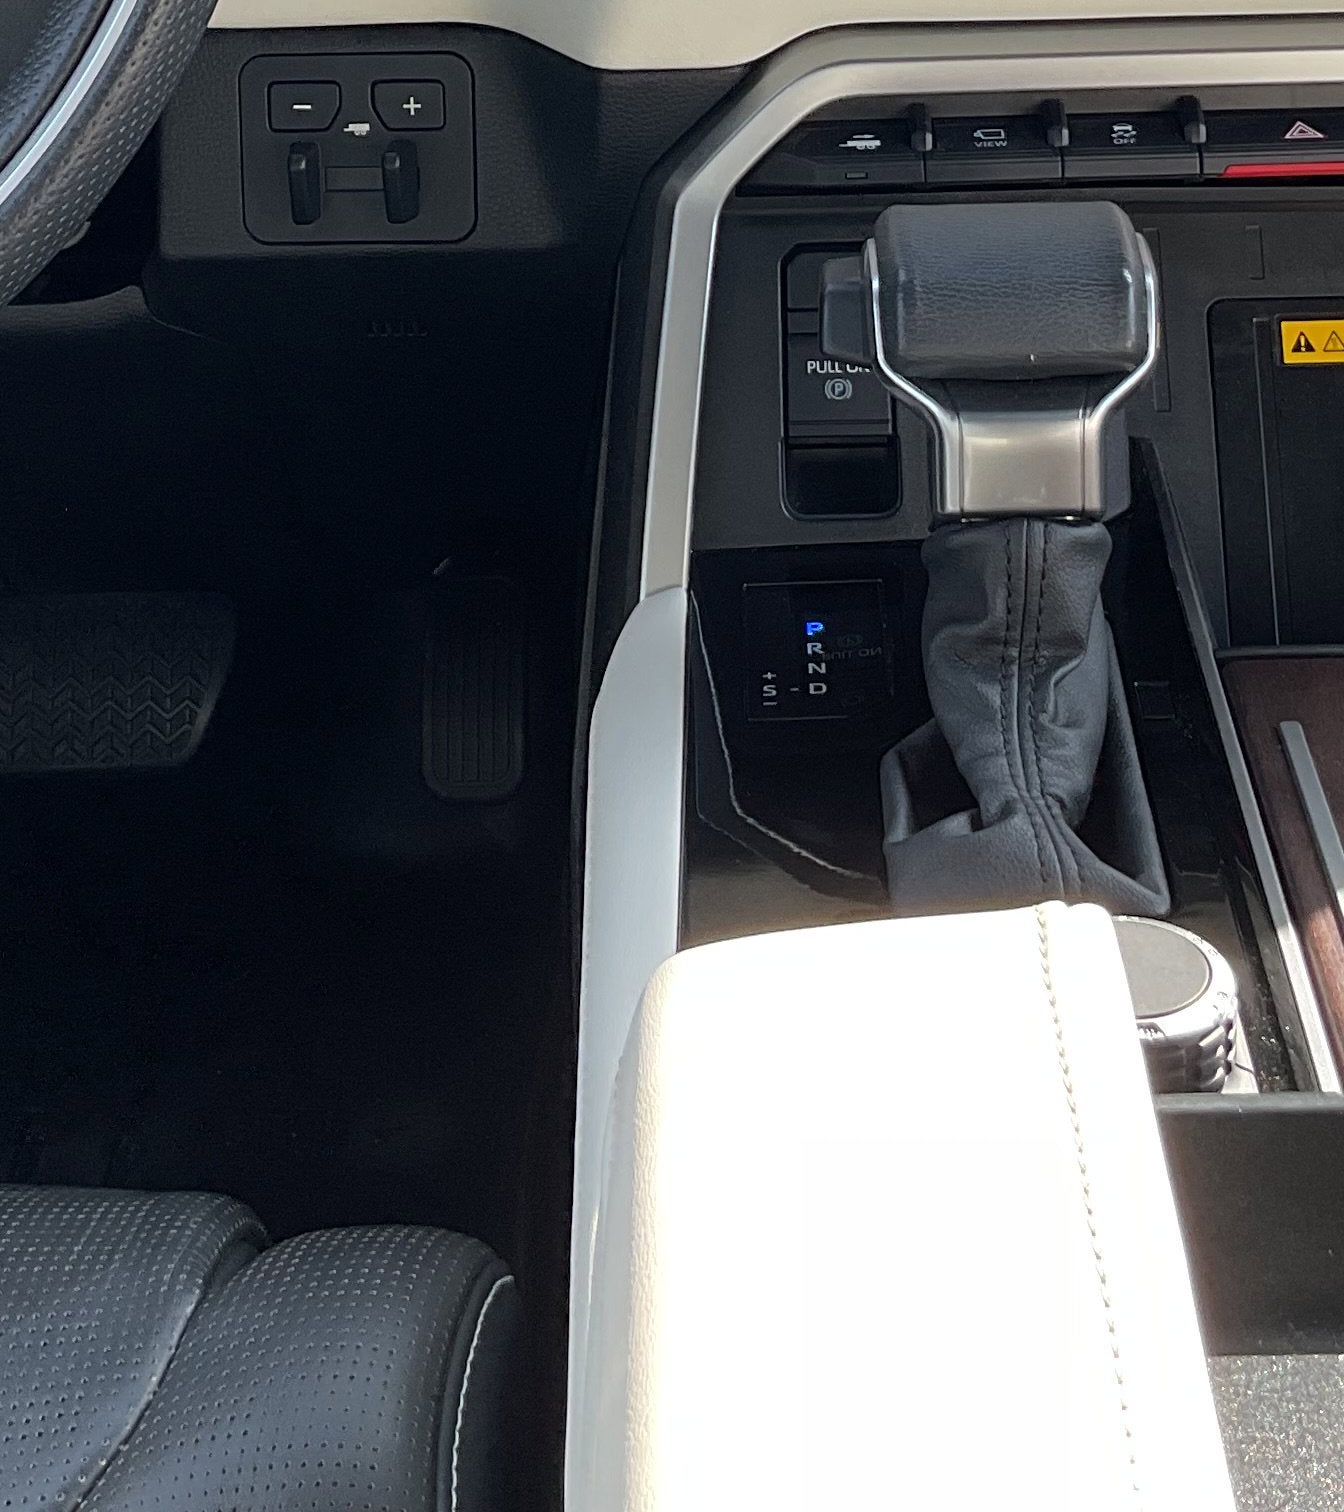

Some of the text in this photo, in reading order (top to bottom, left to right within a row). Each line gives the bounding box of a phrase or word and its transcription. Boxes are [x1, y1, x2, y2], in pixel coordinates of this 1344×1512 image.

[973, 140, 1008, 148] VIEW
[1112, 137, 1137, 145] OFF
[806, 359, 843, 374] PULL
[805, 621, 824, 636] P
[806, 642, 825, 655] R
[807, 662, 827, 675] N
[762, 682, 828, 697] S D
